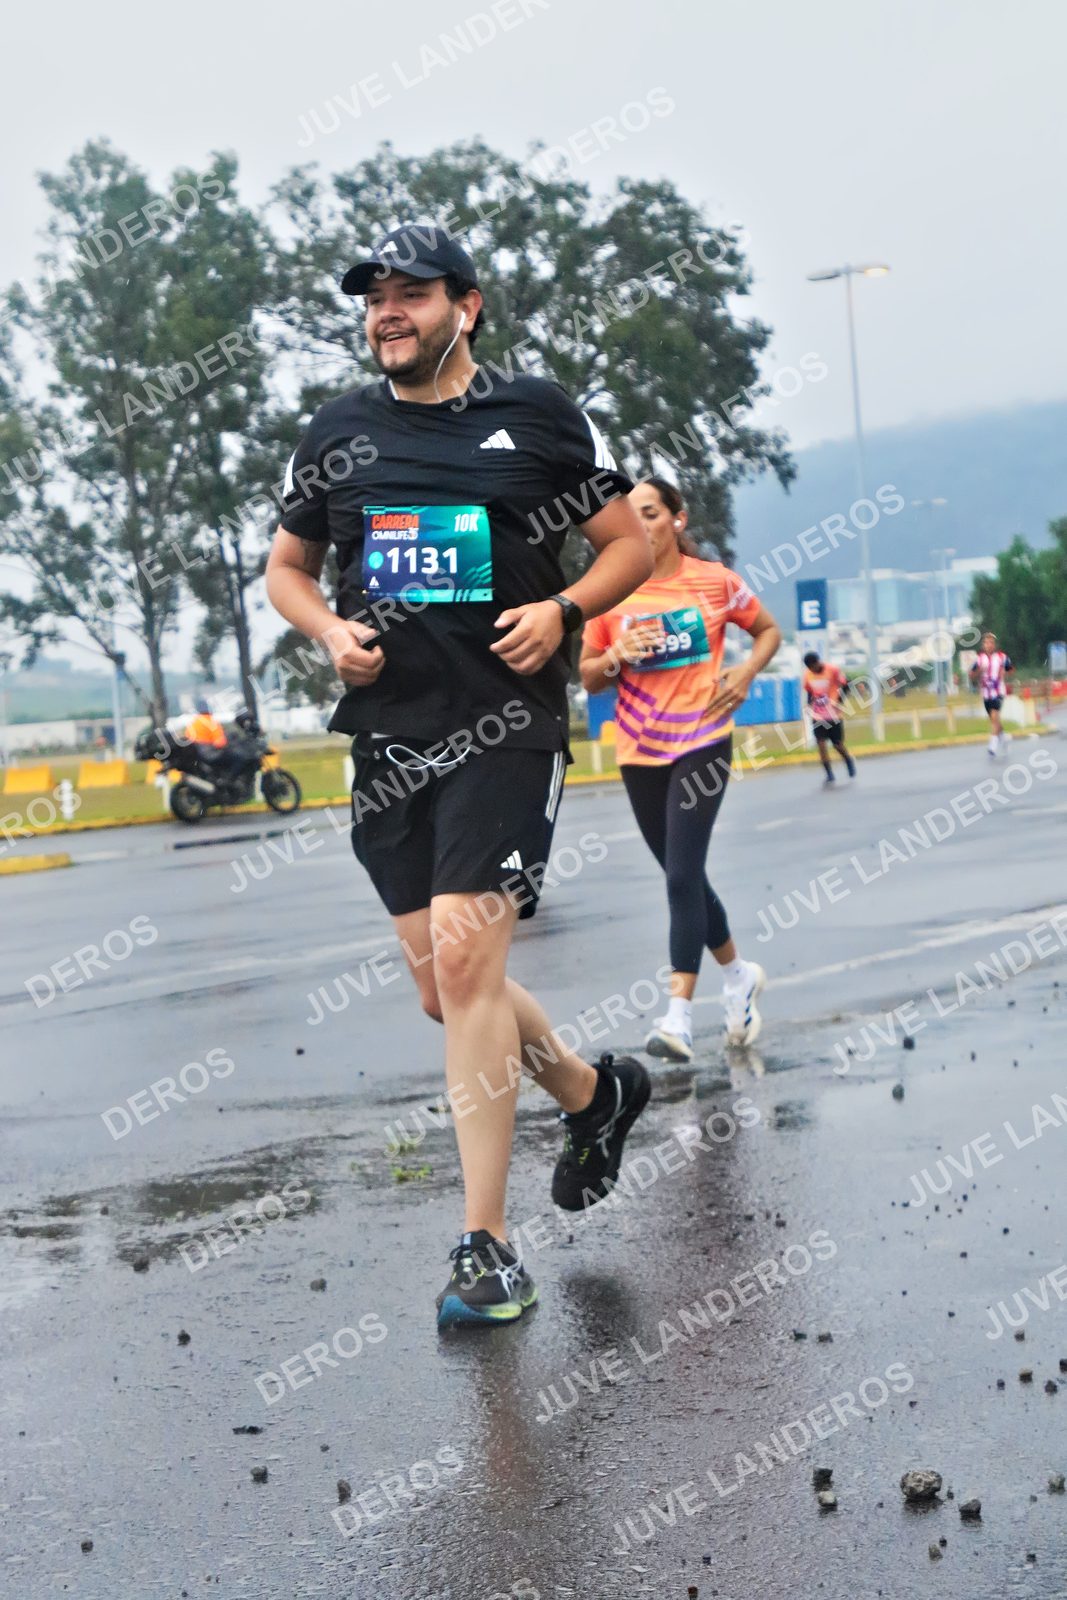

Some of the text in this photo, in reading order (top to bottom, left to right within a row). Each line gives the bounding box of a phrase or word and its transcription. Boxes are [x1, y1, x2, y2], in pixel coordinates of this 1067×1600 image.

[371, 514, 419, 530] CARRERA
[454, 513, 479, 532] 10K
[386, 546, 457, 574] 1131
[801, 600, 821, 625] E
